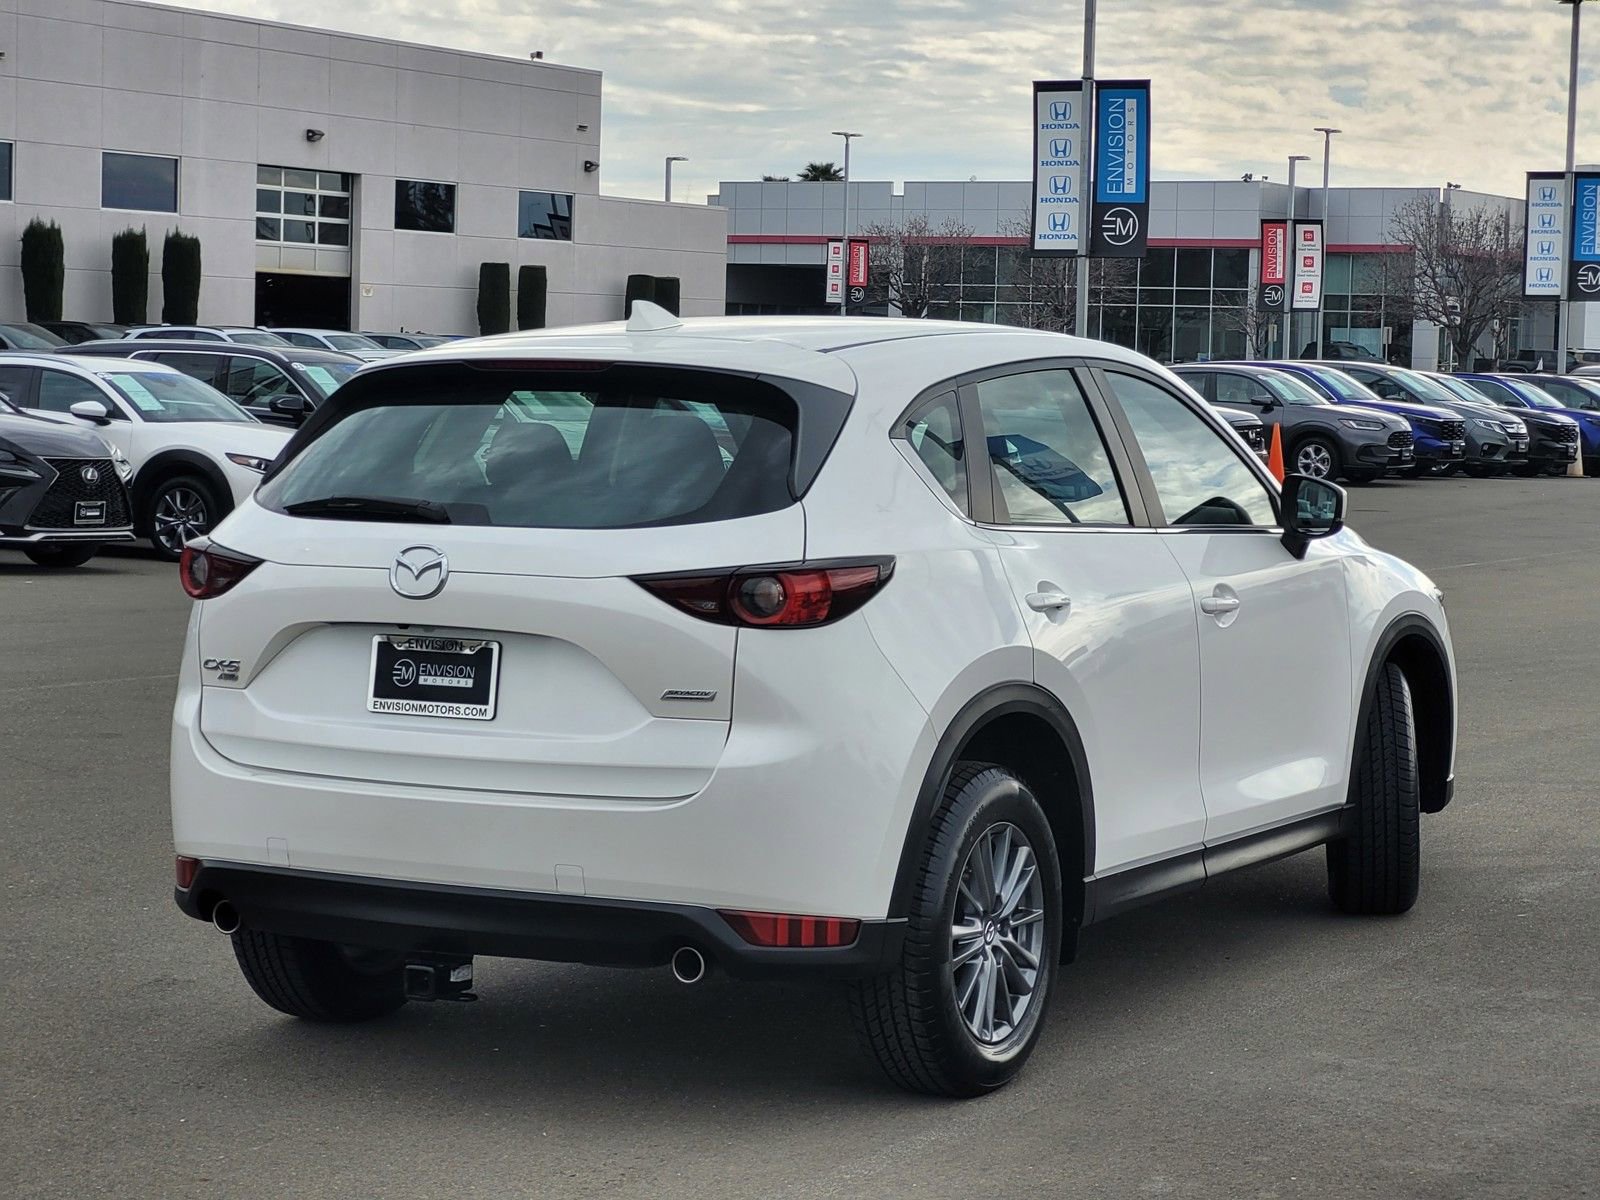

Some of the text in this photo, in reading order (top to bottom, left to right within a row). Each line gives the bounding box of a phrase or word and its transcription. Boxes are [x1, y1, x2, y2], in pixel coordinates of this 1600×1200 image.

[1106, 98, 1124, 194] ENVISION
[1127, 107, 1135, 186] MOTORS
[1581, 185, 1596, 255] ENVISION
[1267, 228, 1276, 279] ENVISION
[408, 638, 464, 651] ENVISION
[418, 663, 476, 678] ENVISION
[422, 678, 469, 686] MOTORS
[373, 700, 488, 717] ENVISIONMOTORS.COM
